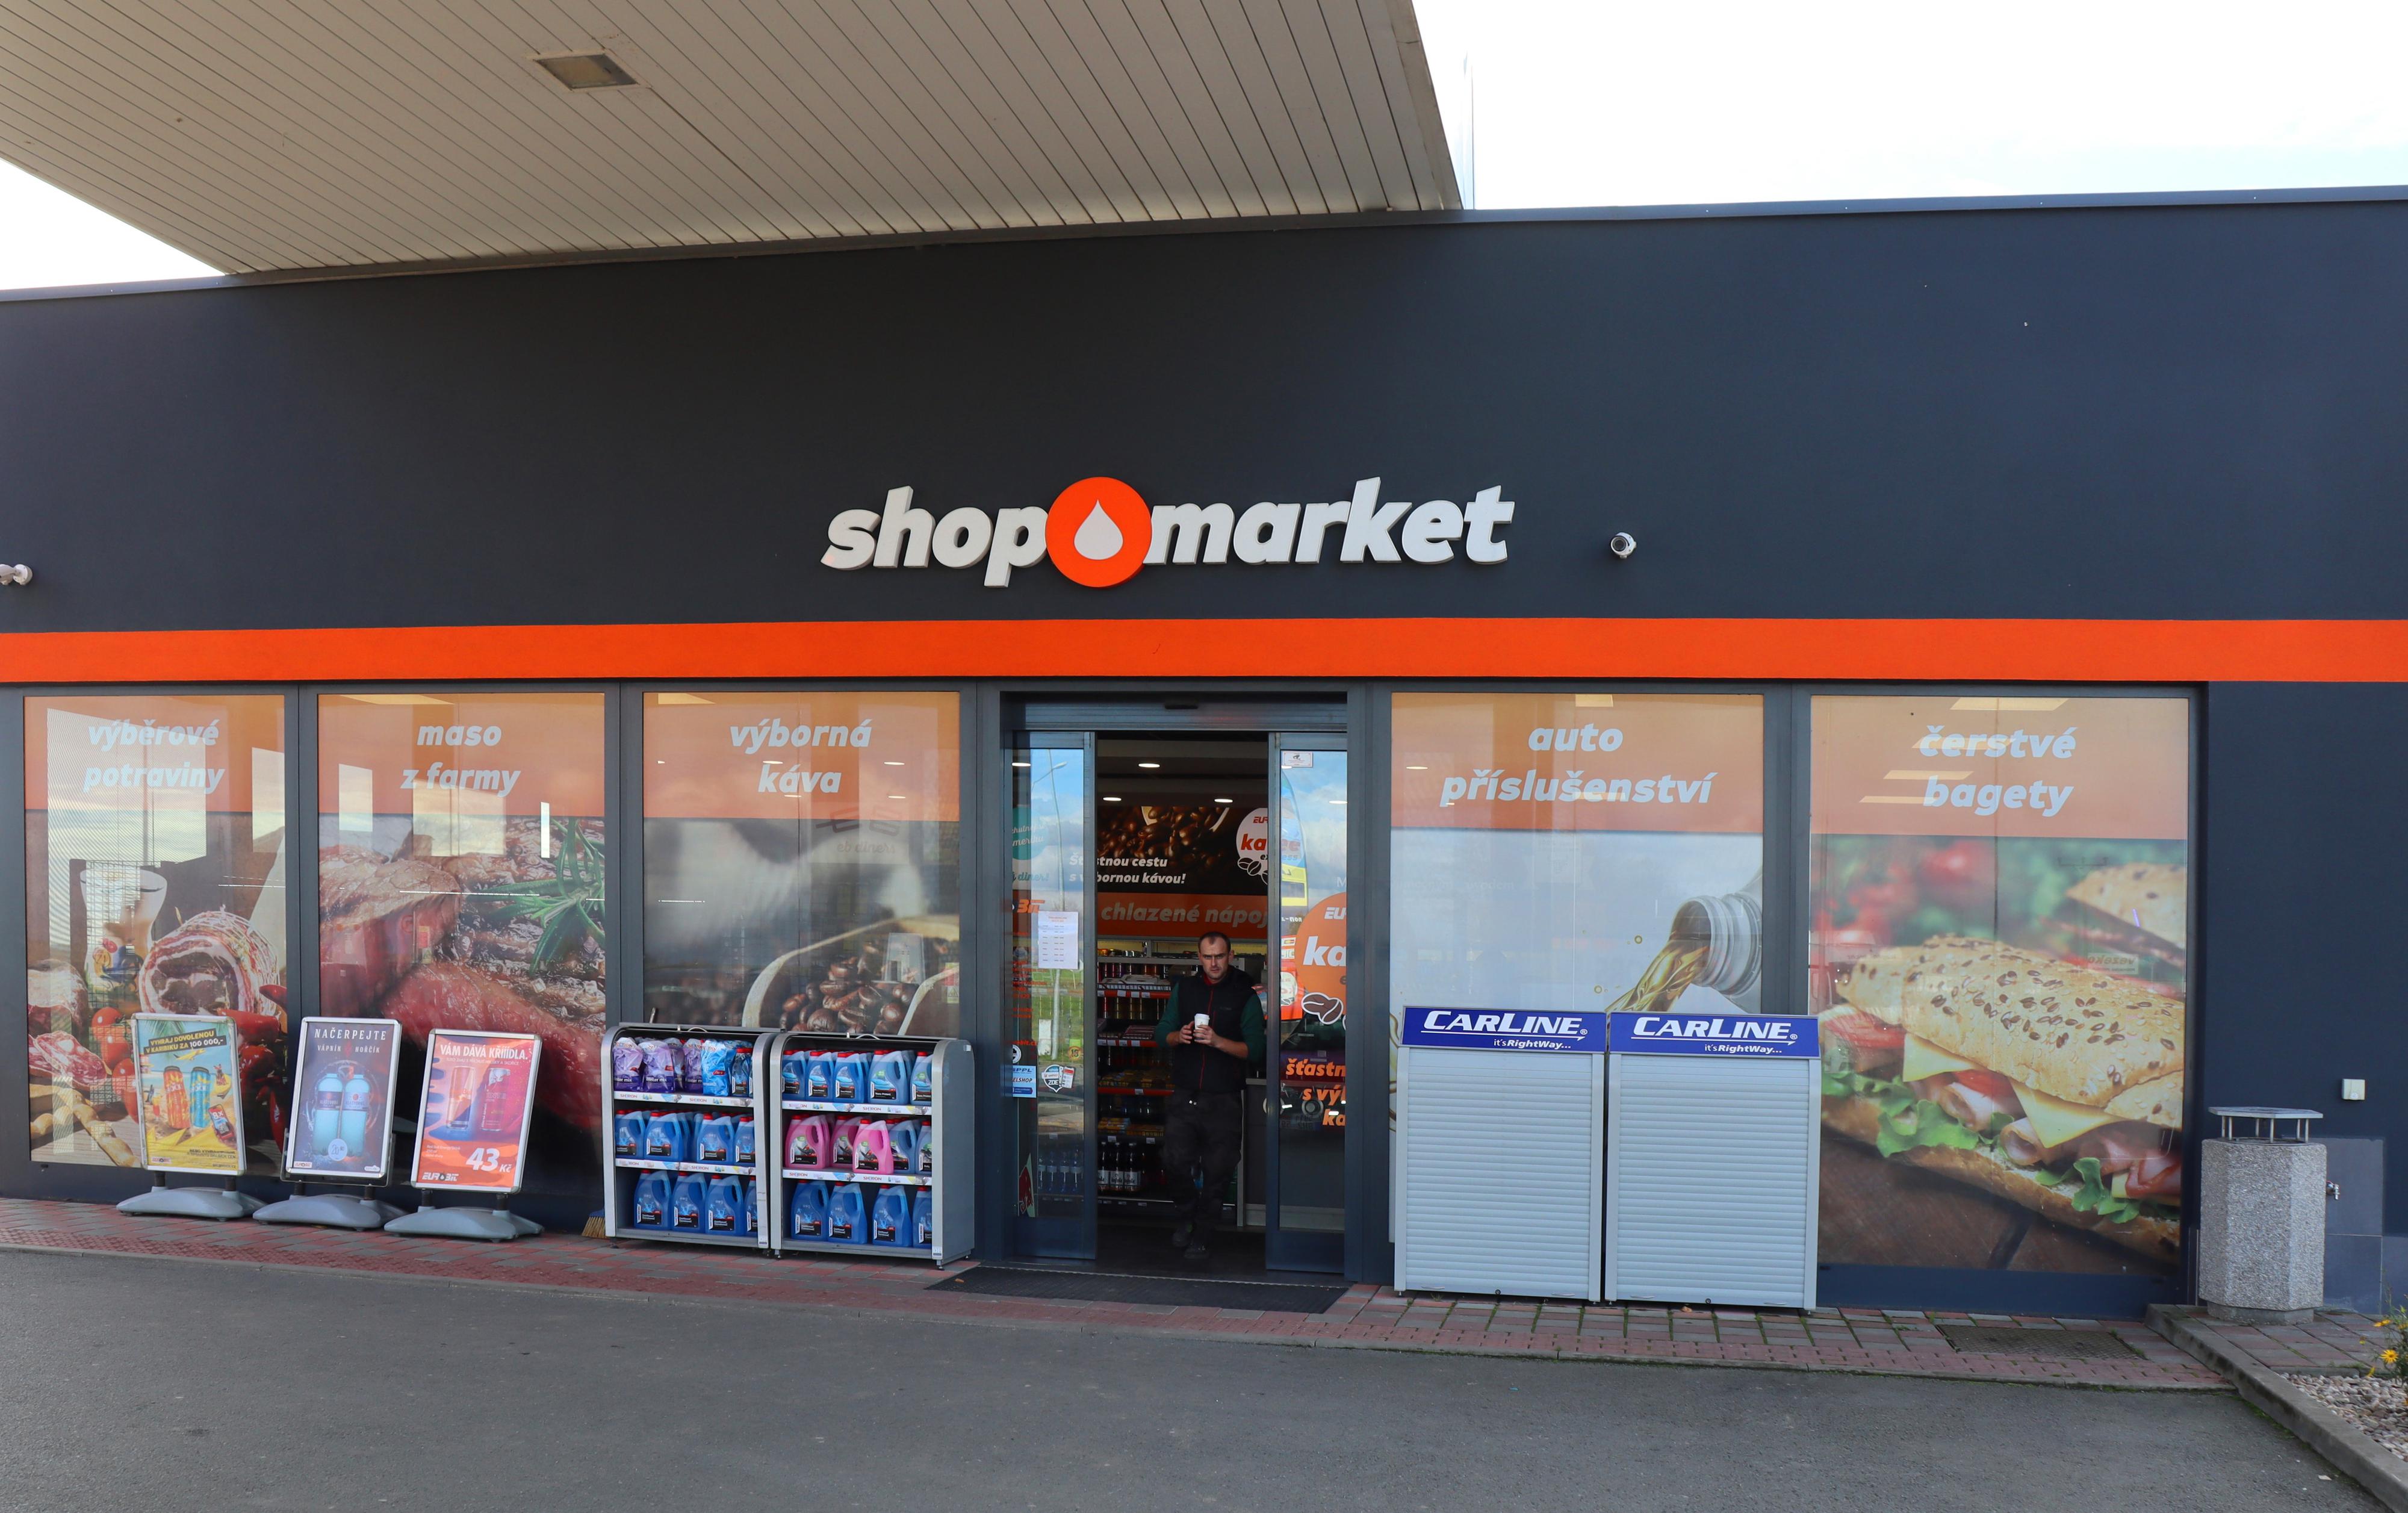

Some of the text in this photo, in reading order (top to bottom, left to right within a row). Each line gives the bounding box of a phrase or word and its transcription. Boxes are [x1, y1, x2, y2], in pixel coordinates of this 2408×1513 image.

[1142, 477, 1515, 564] market
[88, 719, 220, 752] výběrové
[417, 725, 502, 746] maso
[730, 718, 872, 754] výborná
[1528, 723, 1624, 752] auto
[1919, 725, 2078, 759] čerstvé
[82, 761, 225, 795] potraviny
[400, 762, 521, 798] z farmy
[757, 763, 842, 793] káva
[1439, 769, 1719, 807] příslušenství
[1923, 775, 2074, 817] bagety
[1132, 857, 1168, 867] cestu
[1142, 872, 1186, 884] kávou!
[1101, 903, 1200, 922] chlazené
[174, 1030, 215, 1043] DOVOLENOU
[314, 1027, 386, 1040] NAČERPEJTE
[151, 1044, 178, 1052] KARIBIKU
[440, 1042, 461, 1055] VÁM
[463, 1043, 486, 1058] DÁVÁ
[1302, 1089, 1312, 1101] s
[466, 1148, 512, 1173] 43 Kč
